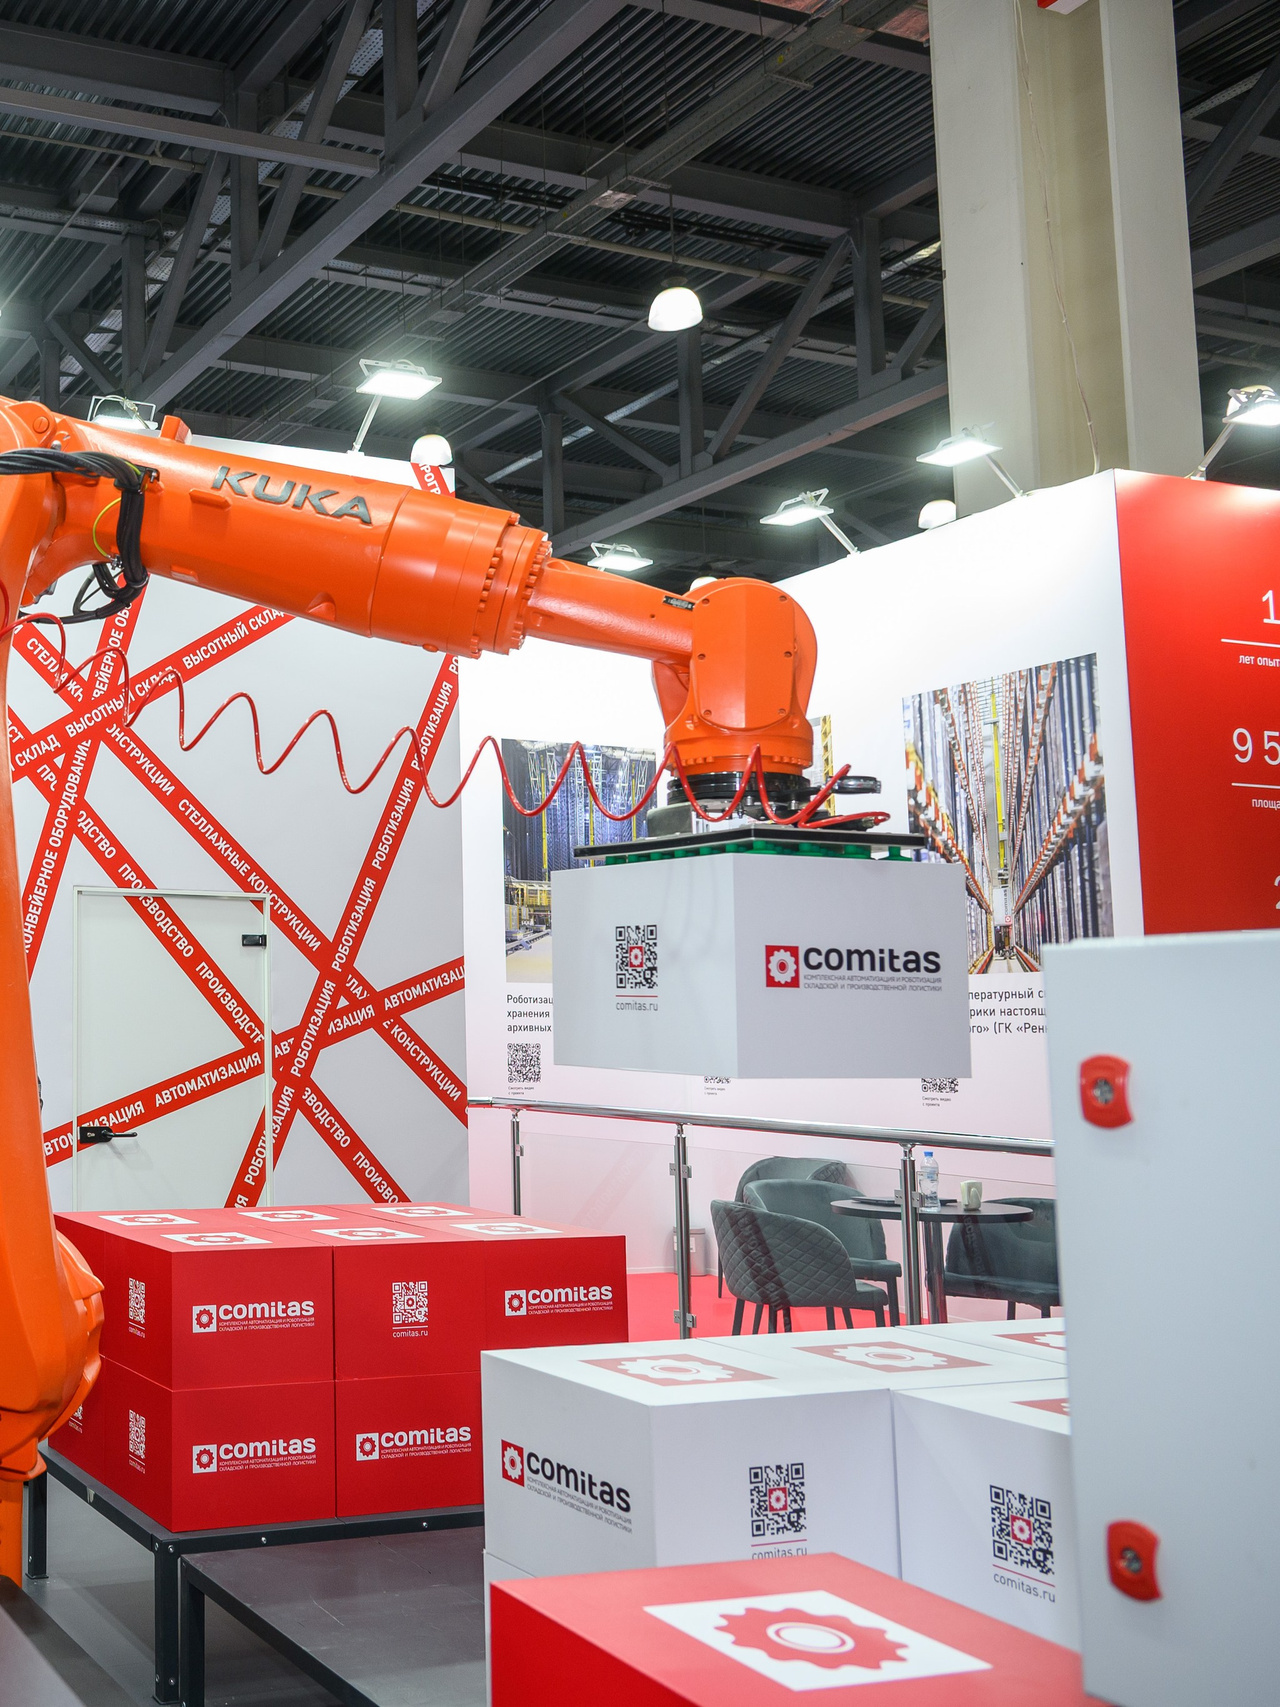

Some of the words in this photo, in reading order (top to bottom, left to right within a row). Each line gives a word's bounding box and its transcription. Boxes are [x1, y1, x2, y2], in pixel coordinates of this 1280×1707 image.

[211, 465, 373, 526] KUKA
[182, 621, 250, 669] ВЫСОТНЫЙ
[249, 610, 286, 631] СКЛА
[1239, 655, 1255, 665] лет
[15, 734, 61, 768] СКЛАД
[105, 723, 176, 796] НСТРУКЦИИ
[179, 798, 250, 876] СТЕЛЛАЖНЫЕ
[372, 777, 416, 870] РОБОТИЗАЦИЯ
[332, 877, 377, 973] РОБОТИЗАЦИЯ
[803, 947, 941, 974] comitas
[384, 964, 466, 1011] АВТОМАТИЗАЦ
[506, 994, 554, 1006] Роботизац
[968, 988, 1034, 1002] пературный
[196, 961, 265, 1045] ПРОИЗВОДСТ
[506, 1009, 550, 1020] хранения
[615, 1000, 659, 1012] comitas.ru
[969, 1008, 996, 1019] рики
[1000, 1007, 1046, 1018] настоящ
[290, 979, 336, 1078] РОБОТИЗАЦИЯ
[507, 1024, 552, 1034] архивных
[993, 1021, 1012, 1035] (ГК
[1016, 1022, 1047, 1034] «Рен
[391, 1024, 462, 1102] КОНСТРУКЦИИ
[156, 1051, 261, 1107] АВТОМАТИЗАЦИЯ
[302, 1087, 351, 1148] ЗВОДСТВО
[353, 1151, 403, 1205] ПРОИЗВО
[528, 1285, 612, 1304] comitas
[218, 1301, 315, 1320] comitas
[393, 1330, 428, 1338] comitas.ru
[219, 1437, 316, 1460] comitas
[381, 1426, 471, 1448] comitas
[527, 1452, 631, 1513] comitas
[993, 1573, 1056, 1603] comitas.ru
